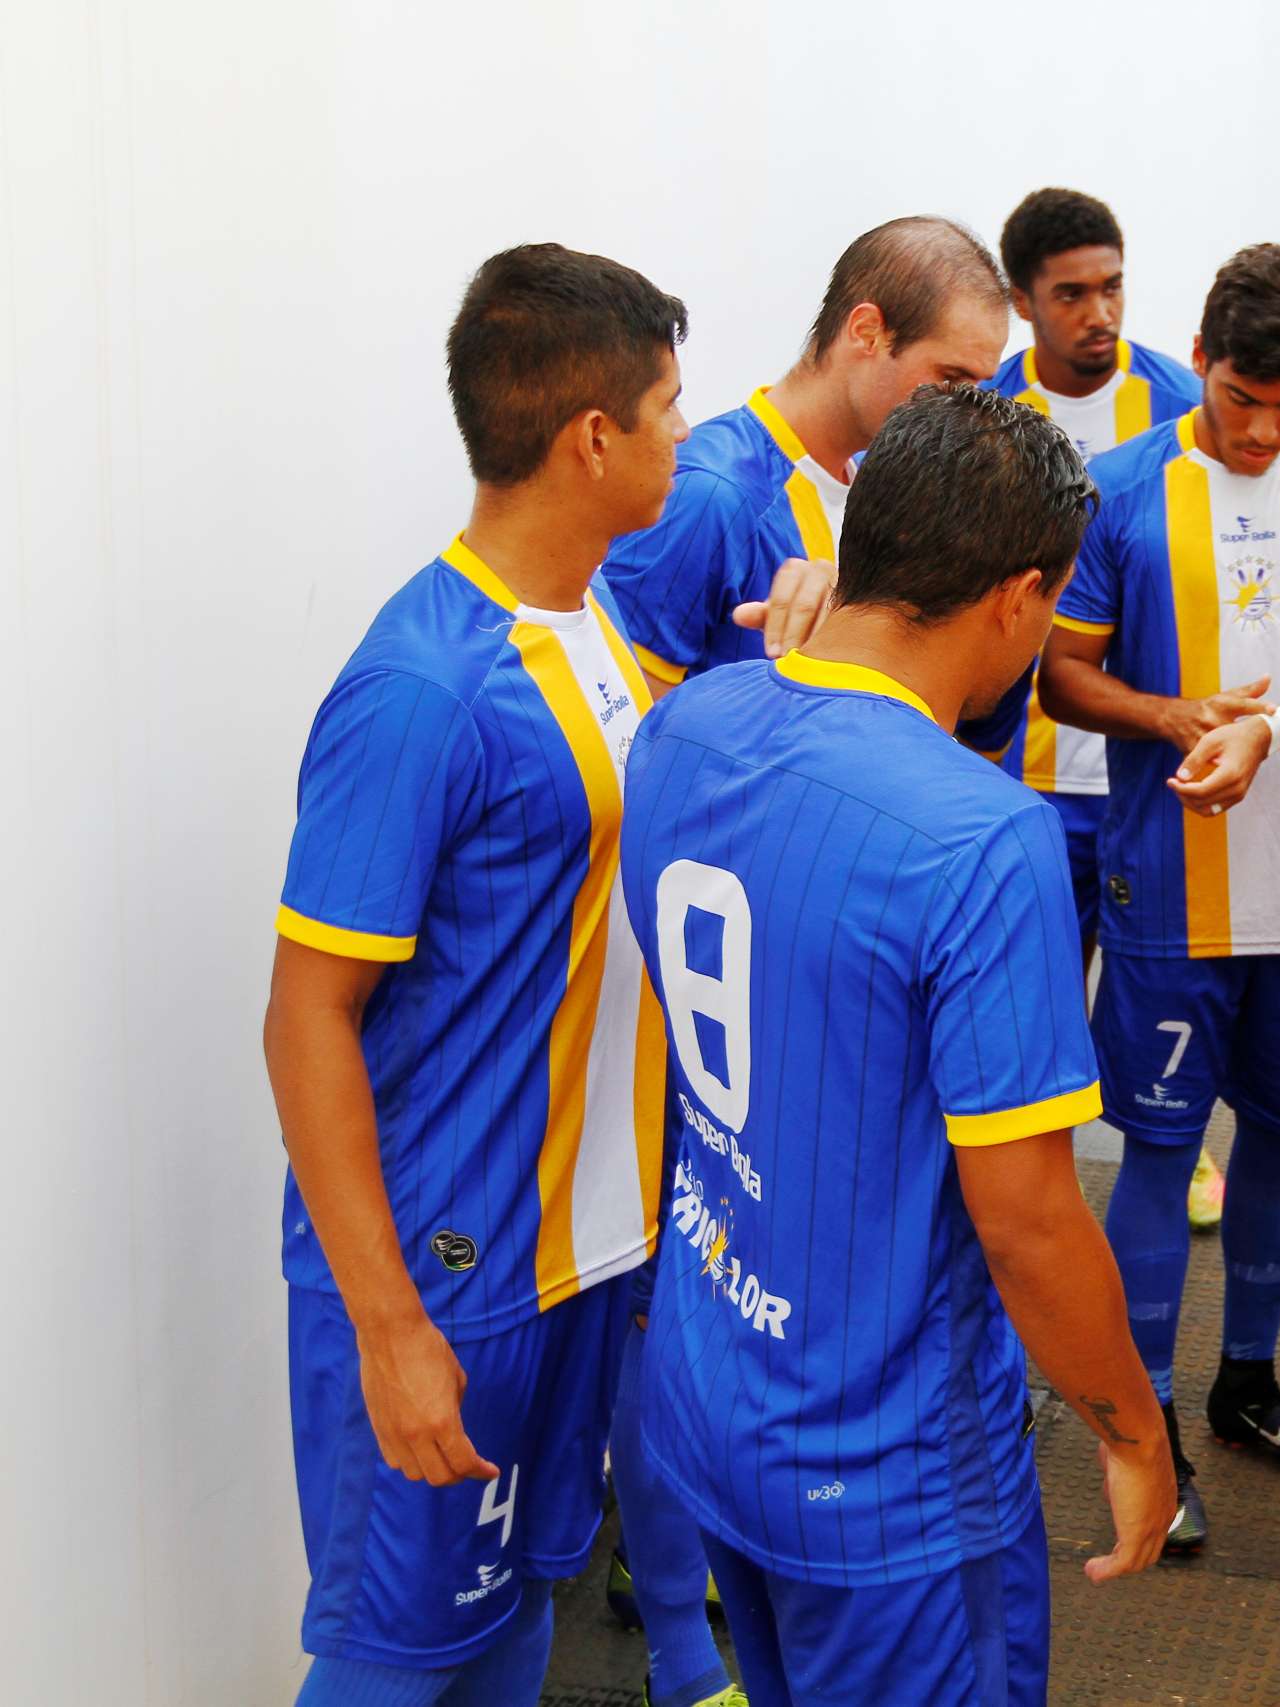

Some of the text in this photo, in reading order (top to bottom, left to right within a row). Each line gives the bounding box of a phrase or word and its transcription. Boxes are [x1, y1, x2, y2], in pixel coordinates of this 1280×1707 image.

[656, 859, 752, 1134] 8
[1156, 1020, 1193, 1079] 7
[679, 1092, 729, 1156] Super
[477, 1463, 520, 1549] 4
[455, 1589, 489, 1606] Super
